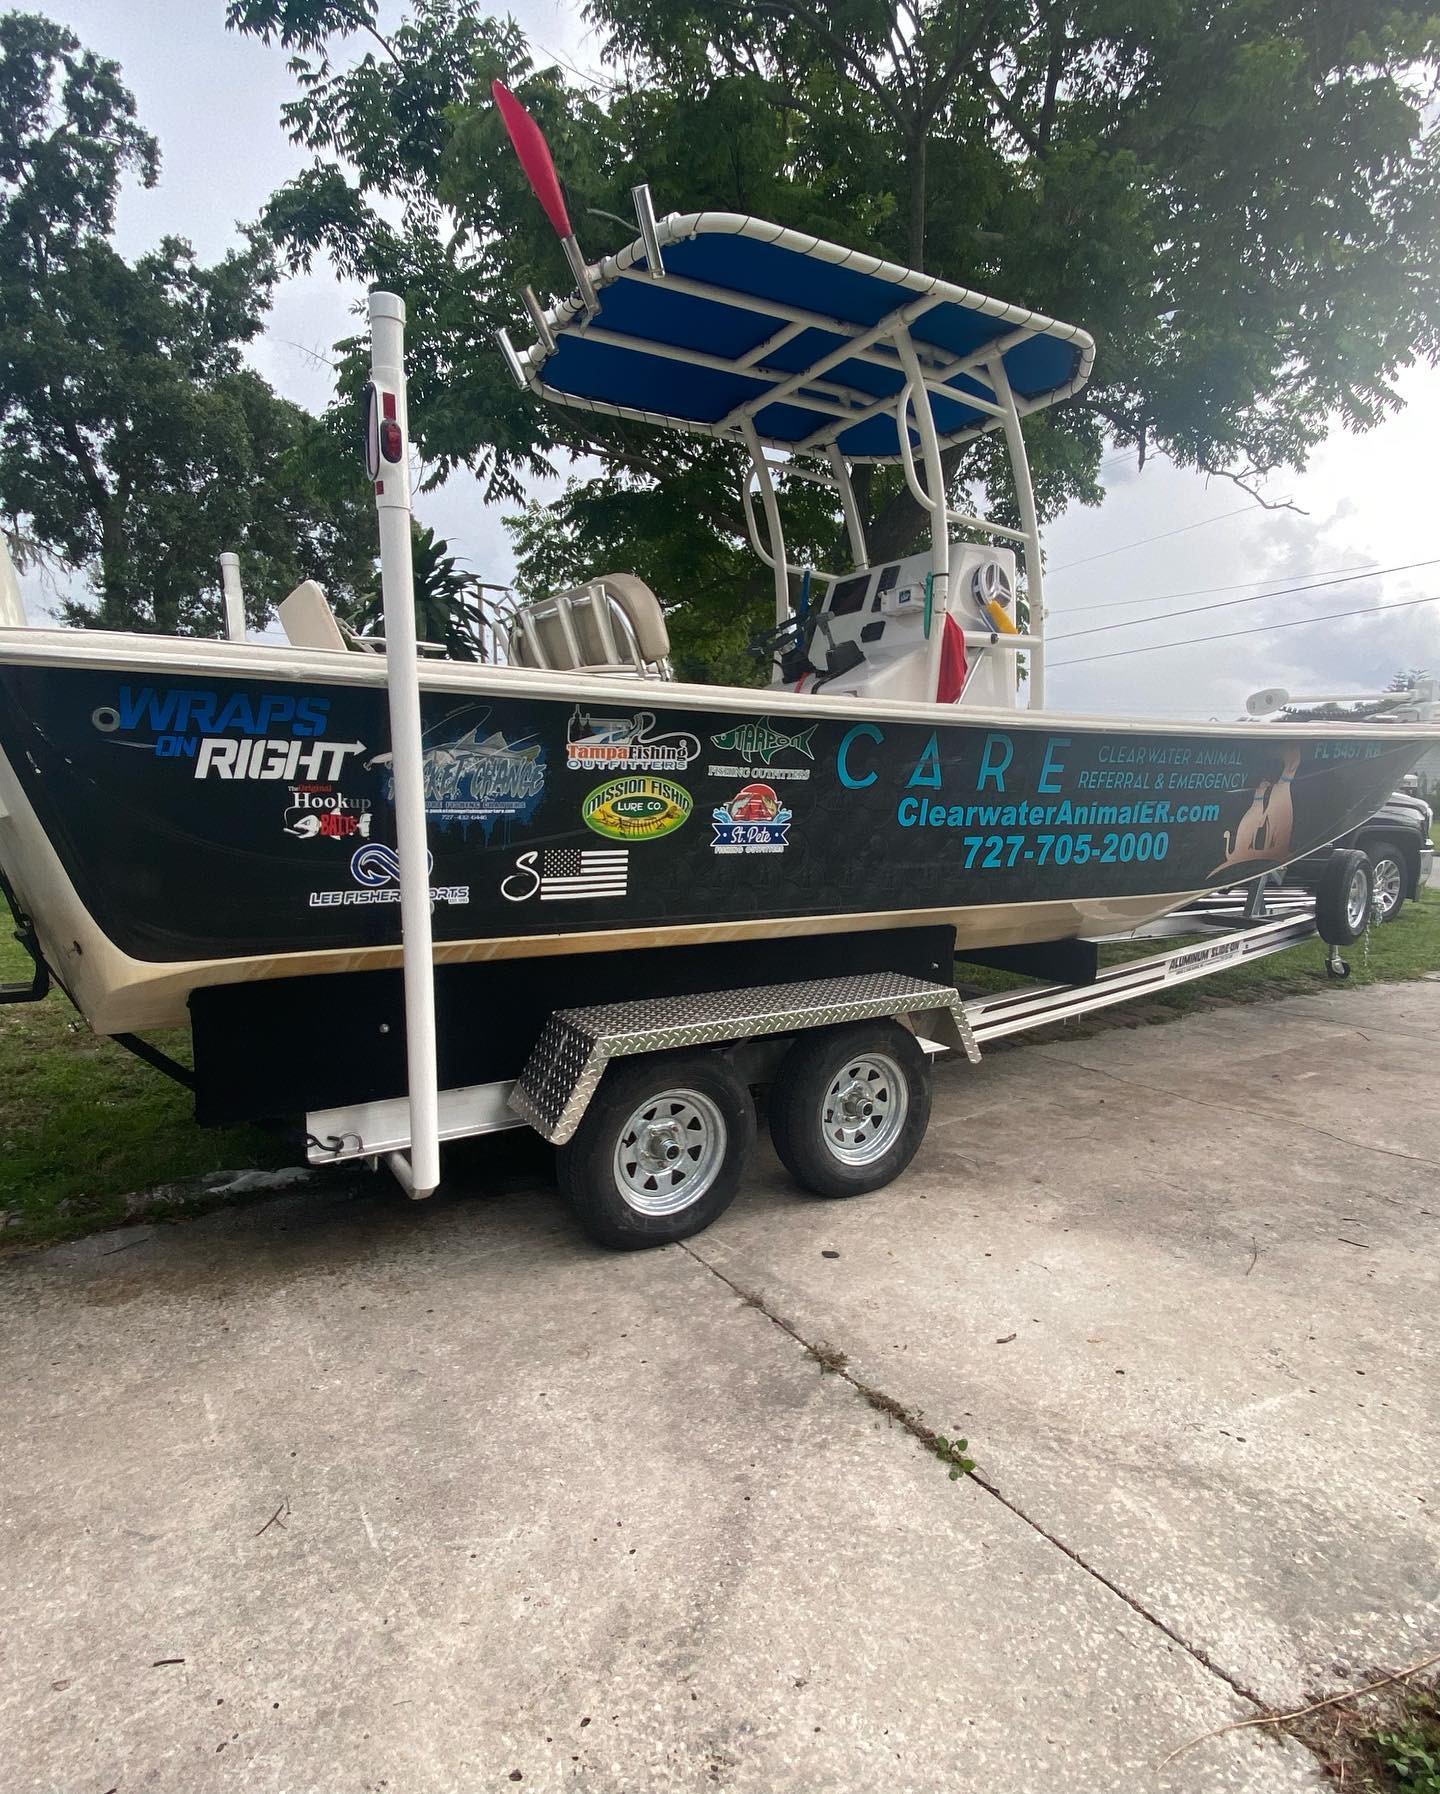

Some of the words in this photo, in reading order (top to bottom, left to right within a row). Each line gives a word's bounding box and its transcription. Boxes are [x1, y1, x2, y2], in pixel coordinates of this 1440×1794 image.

[119, 686, 331, 736] WRAPS
[155, 736, 197, 757] ON
[194, 738, 362, 781] RIGHT
[567, 760, 688, 770] OUTFITTERS
[1098, 746, 1191, 765] CLEARWATER
[1195, 750, 1242, 765] ANIMAL
[1078, 771, 1150, 789] REFERRAL
[1154, 773, 1164, 789] &
[1168, 773, 1248, 789] EMERGENCY
[293, 792, 371, 813] Hookup
[588, 779, 646, 816] MISSION
[617, 801, 643, 812] LURE
[647, 801, 663, 811] CO.
[897, 797, 1220, 827] ClearwaterAnimalER.com
[963, 832, 1169, 868] 727-705-2000
[310, 893, 342, 906] LEE
[344, 890, 401, 905] FISHER
[1169, 948, 1209, 970] ALUMINUM
